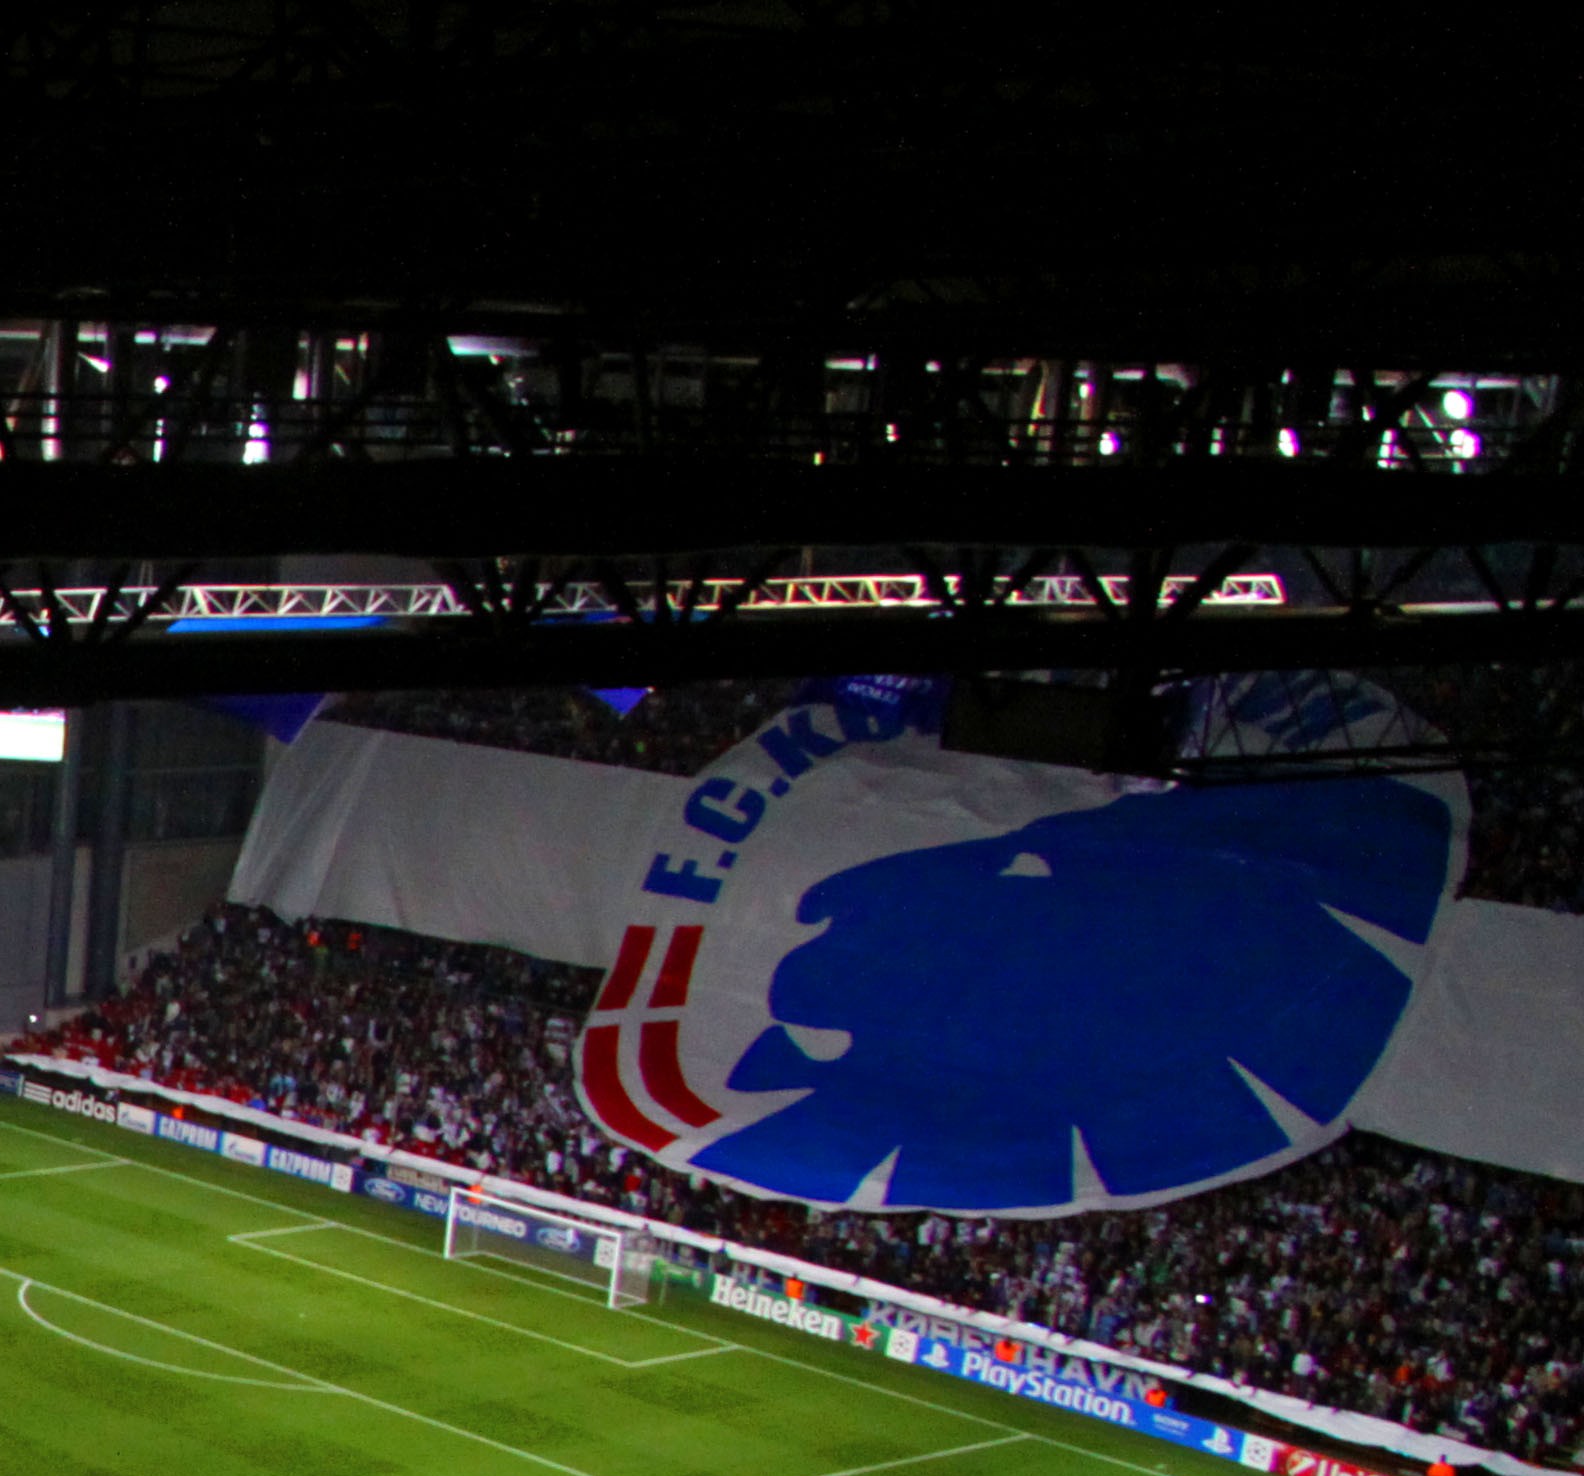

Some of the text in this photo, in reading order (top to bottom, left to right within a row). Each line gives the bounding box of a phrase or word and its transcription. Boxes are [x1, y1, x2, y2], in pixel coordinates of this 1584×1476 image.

[52, 1088, 117, 1123] adidas
[159, 1118, 218, 1150] GAZPROM
[413, 1191, 449, 1216] NEW
[710, 1273, 844, 1341] Heineken
[961, 1351, 1134, 1425] PlayStation
